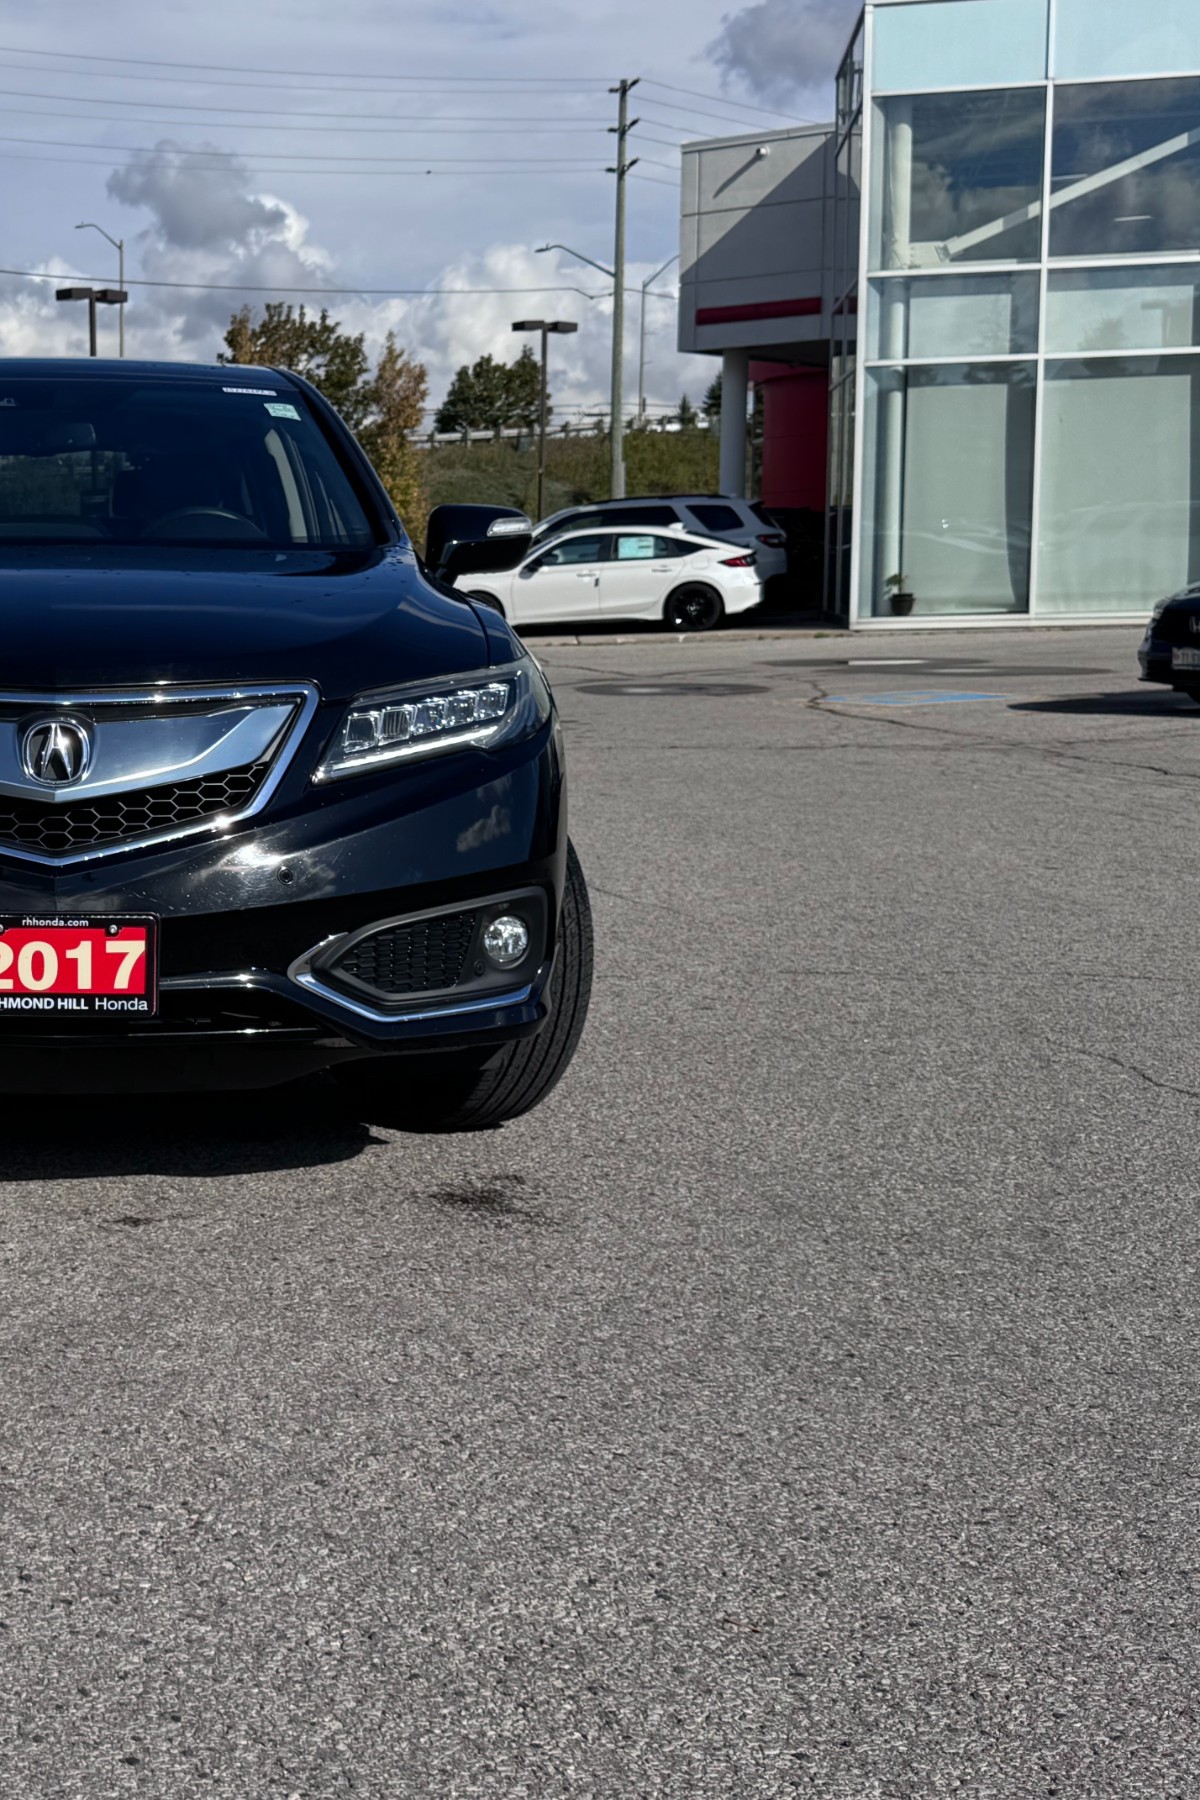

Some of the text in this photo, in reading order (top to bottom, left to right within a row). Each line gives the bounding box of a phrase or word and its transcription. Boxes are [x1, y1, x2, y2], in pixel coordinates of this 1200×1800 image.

[22, 917, 89, 927] rhhonda.com
[57, 998, 89, 1010] HILL
[95, 998, 149, 1011] Honda
